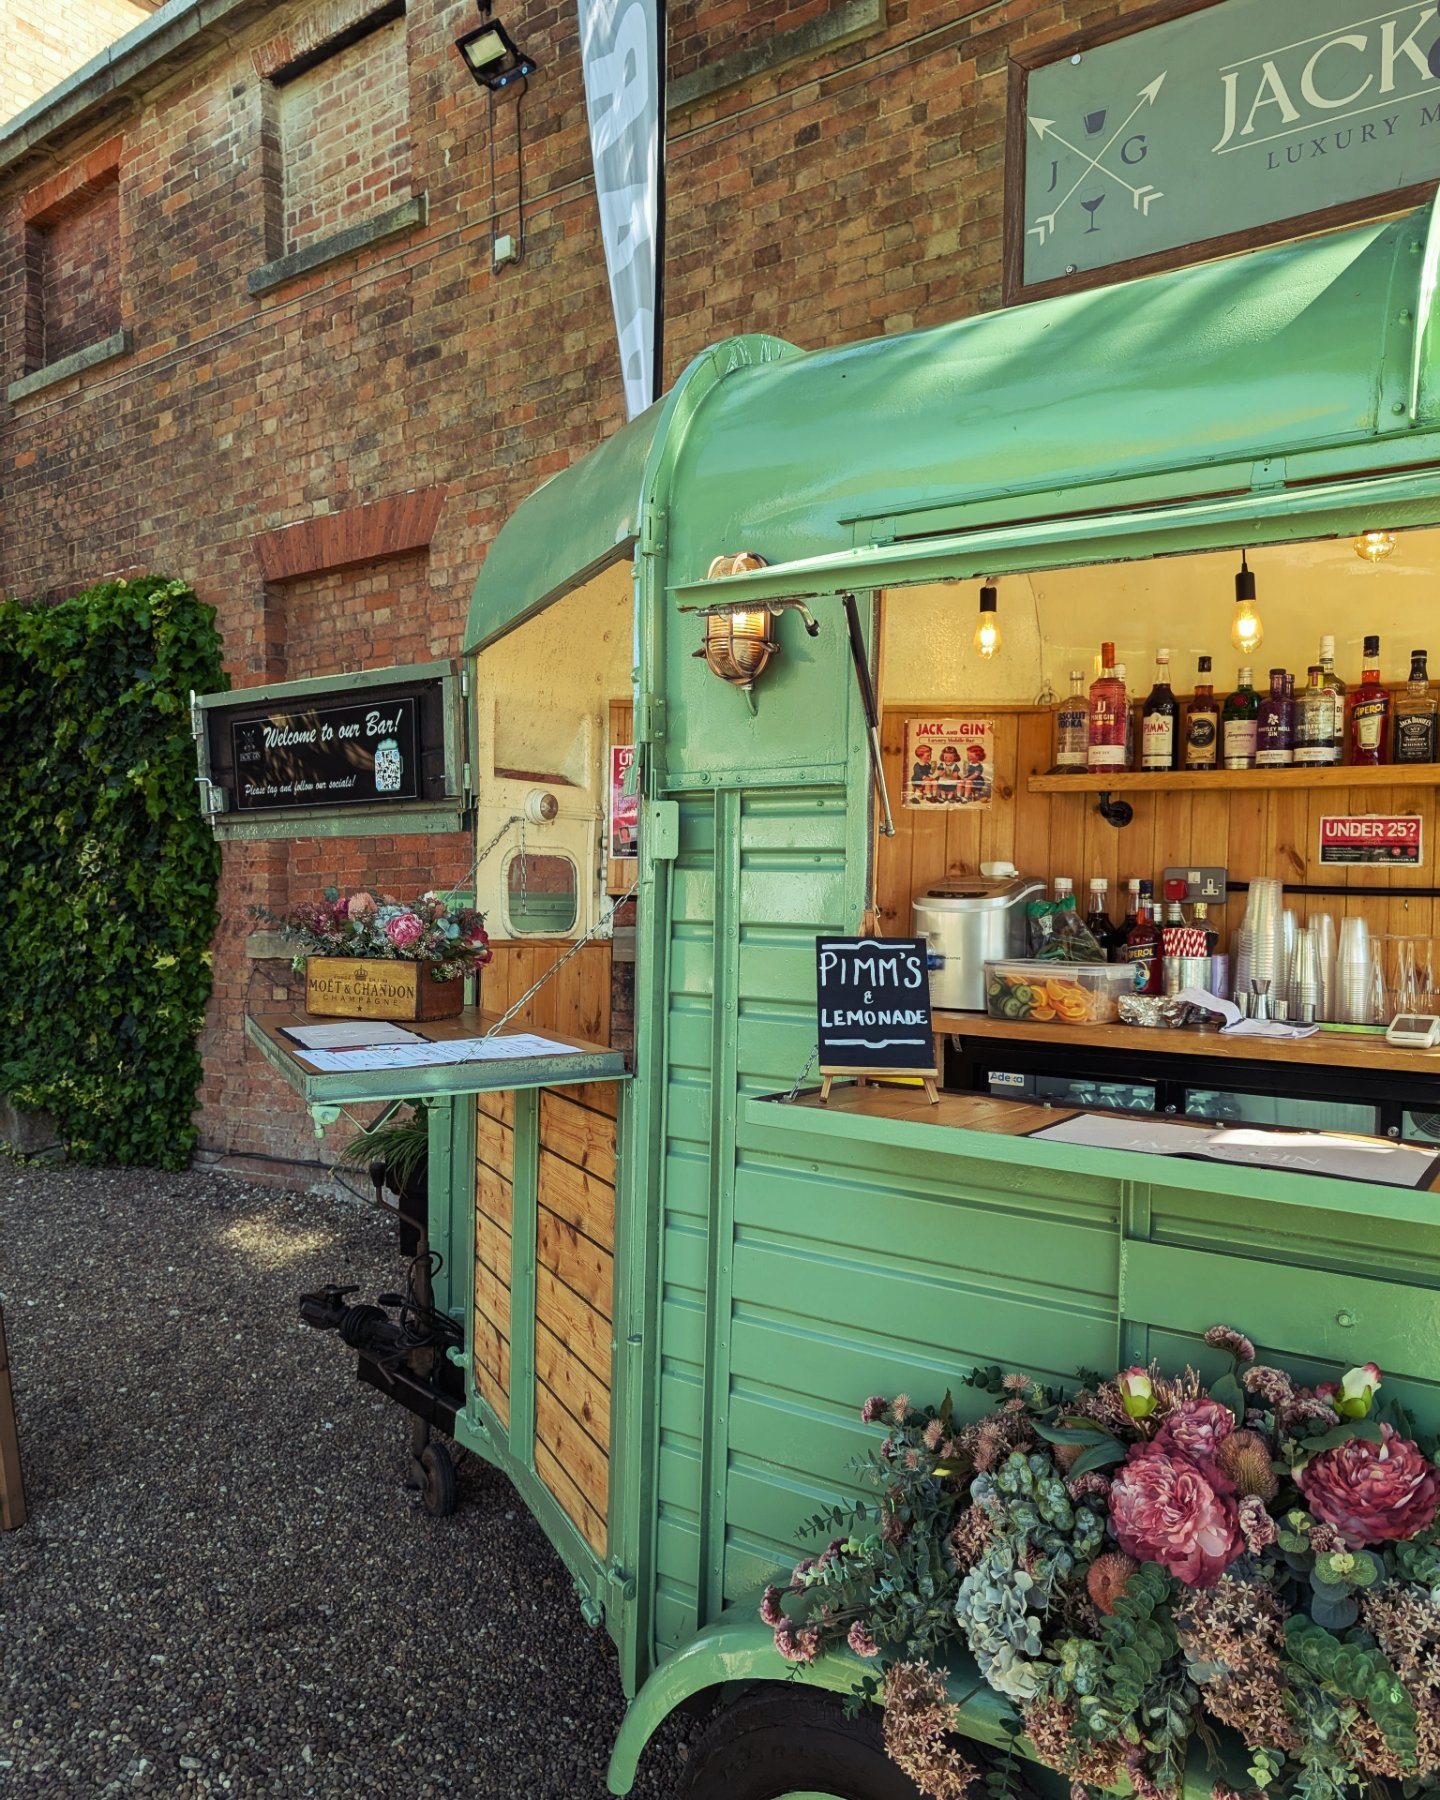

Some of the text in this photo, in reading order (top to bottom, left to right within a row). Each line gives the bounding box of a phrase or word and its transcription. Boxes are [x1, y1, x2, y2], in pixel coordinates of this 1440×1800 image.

[1211, 8, 1440, 154] JACK
[1120, 134, 1148, 165] G
[1267, 115, 1400, 171] LUXURY
[1047, 160, 1058, 193] J
[263, 708, 403, 749] Welcome to our Bar!
[916, 723, 944, 736] JACK
[960, 723, 985, 735] GIN
[244, 774, 356, 797] Please tag and follow our socials!
[1325, 822, 1417, 837] UNDER 25?
[819, 951, 922, 988] PIMM'S
[309, 979, 342, 993] MOËT
[344, 984, 351, 994] &
[353, 982, 414, 998] CHANDON
[323, 994, 400, 1006] CHAMPAGNE
[864, 990, 874, 1004] &
[821, 1008, 928, 1027] LEMONADE
